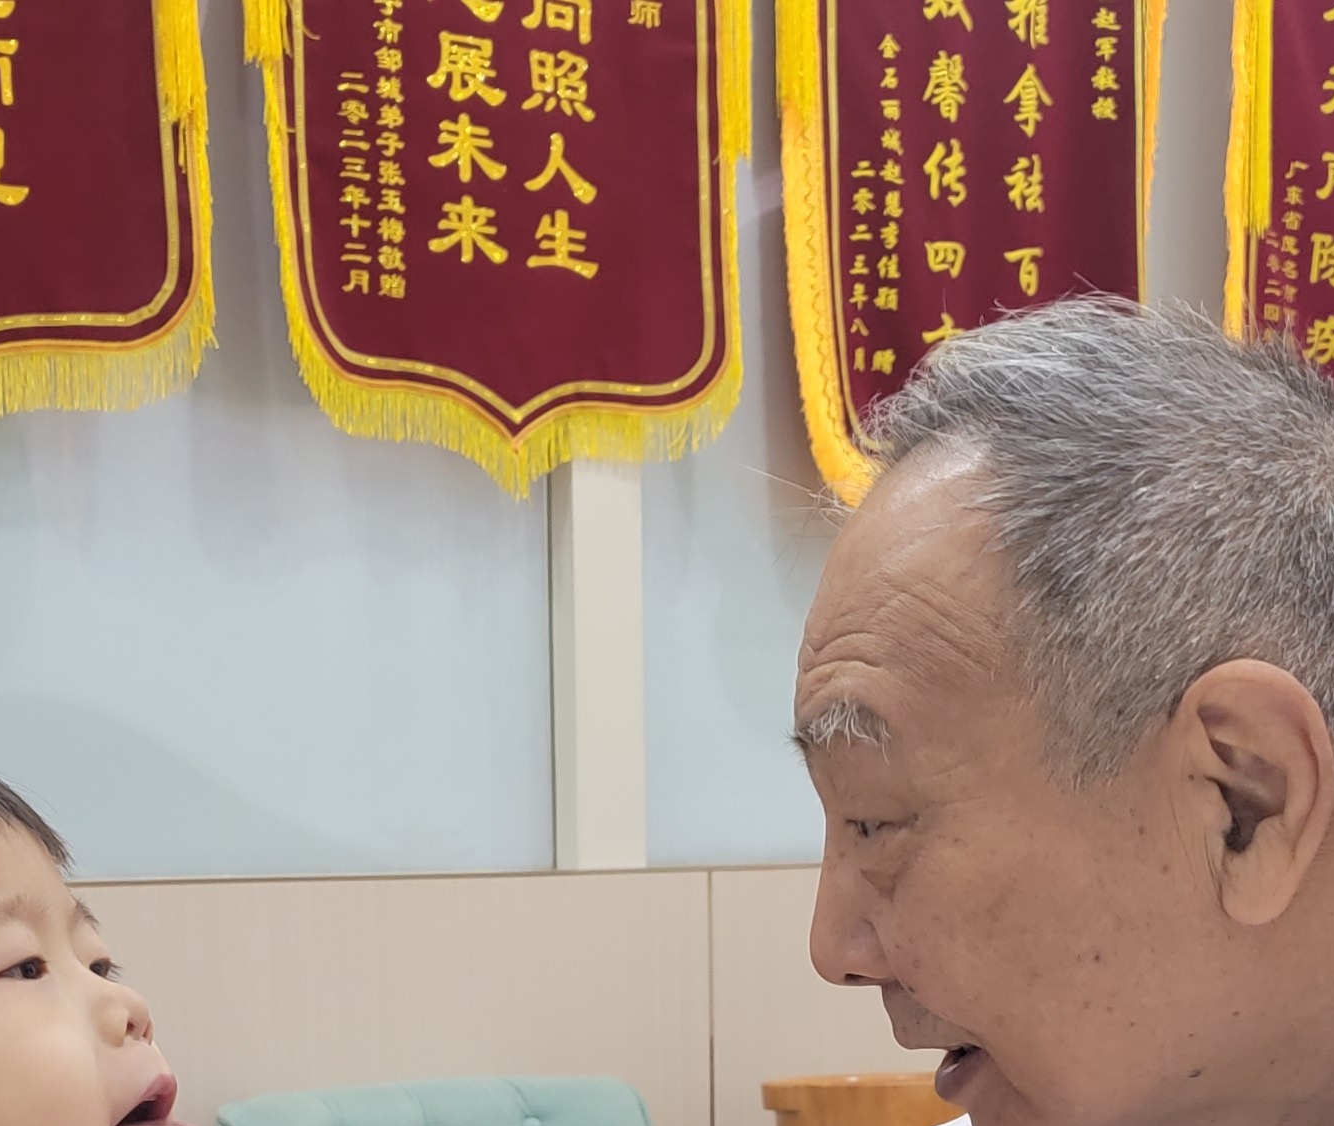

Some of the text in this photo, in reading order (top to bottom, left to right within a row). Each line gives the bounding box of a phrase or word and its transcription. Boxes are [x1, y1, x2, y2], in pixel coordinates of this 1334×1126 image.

[336, 72, 372, 295] 二零二三年十二月
[426, 0, 509, 265] 展未来
